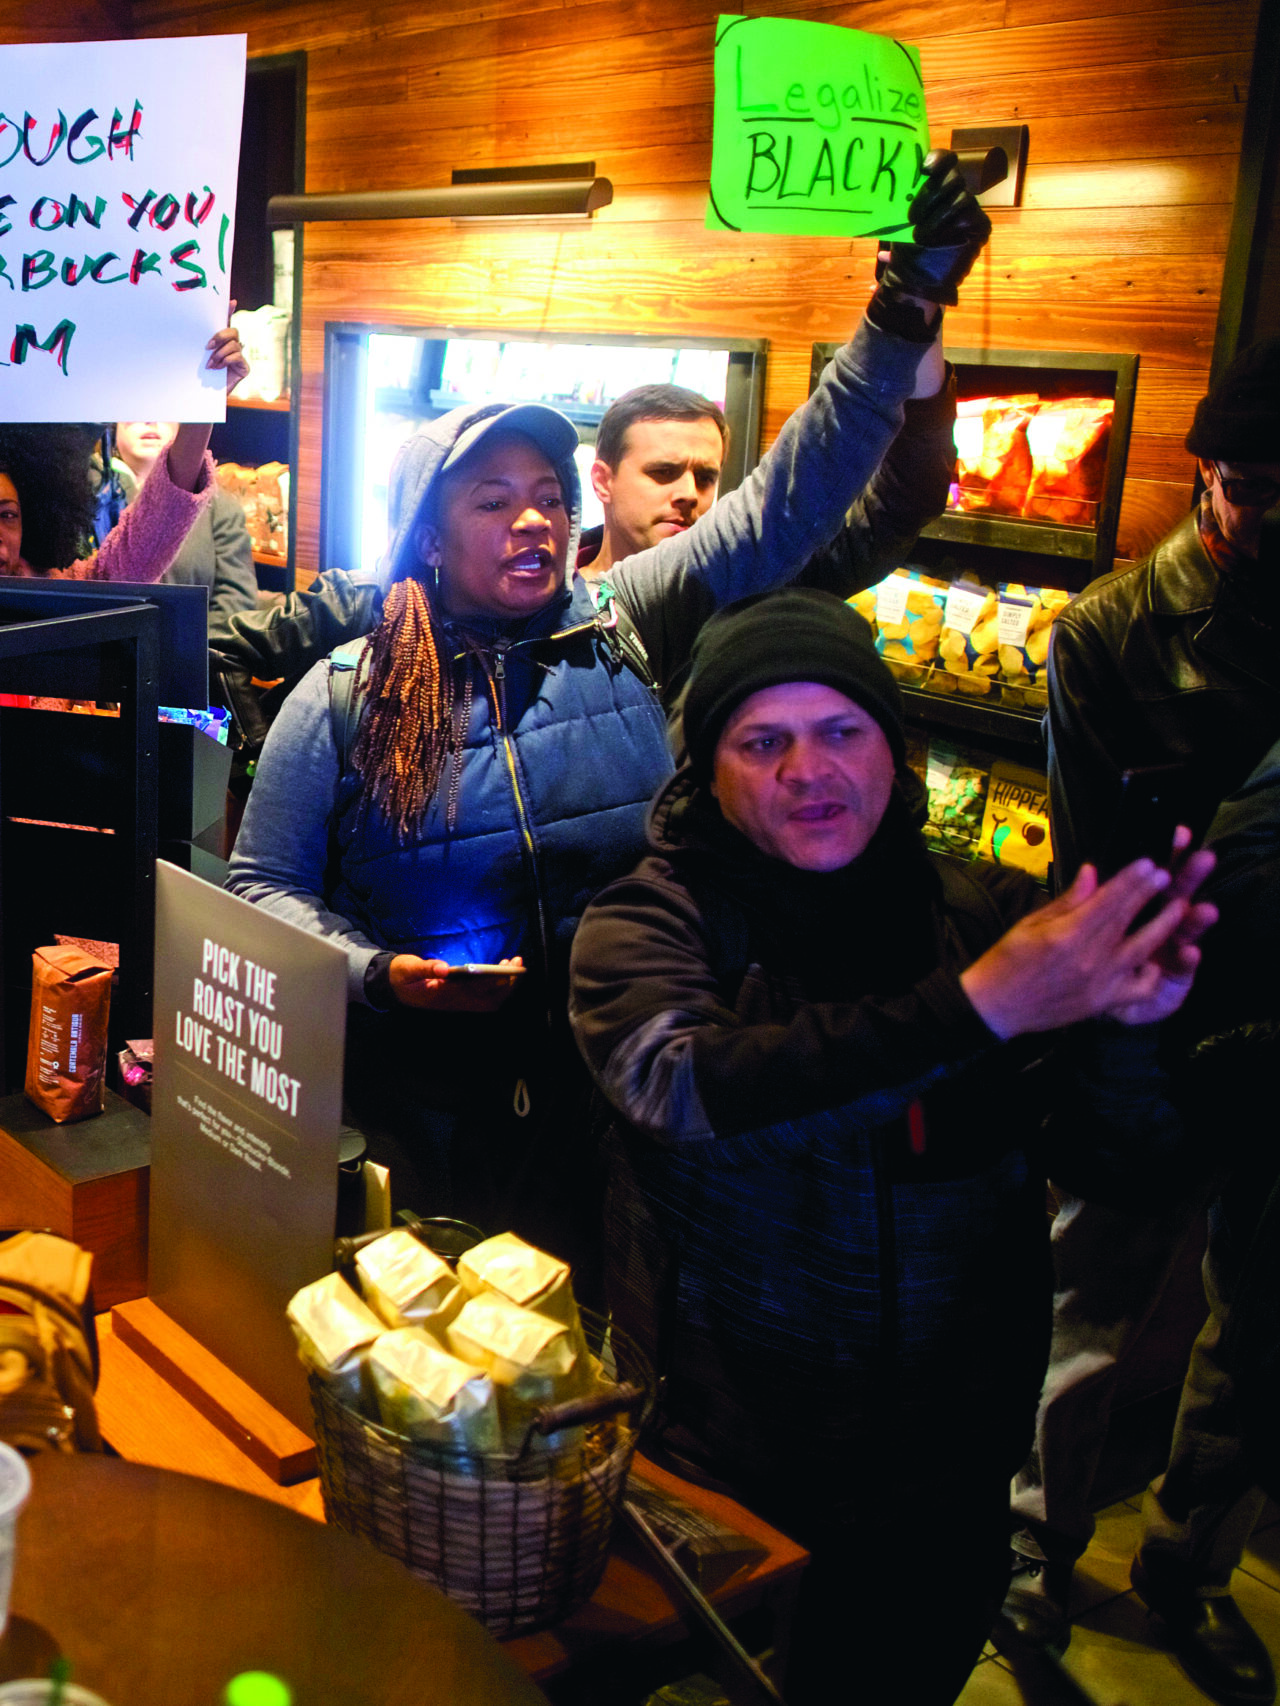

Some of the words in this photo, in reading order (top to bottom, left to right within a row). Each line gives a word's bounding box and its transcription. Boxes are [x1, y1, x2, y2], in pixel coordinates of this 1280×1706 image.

[736, 45, 922, 132] Legalize
[745, 131, 924, 203] BLACK!
[30, 193, 108, 232] ON
[121, 185, 216, 232] YOU
[202, 938, 240, 991] PICK
[244, 959, 277, 1011] THE
[193, 978, 245, 1038] ROAST
[248, 1009, 283, 1060] YOU
[176, 1011, 212, 1065] LOVE
[216, 1035, 247, 1086] THE
[250, 1057, 301, 1117] MOST
